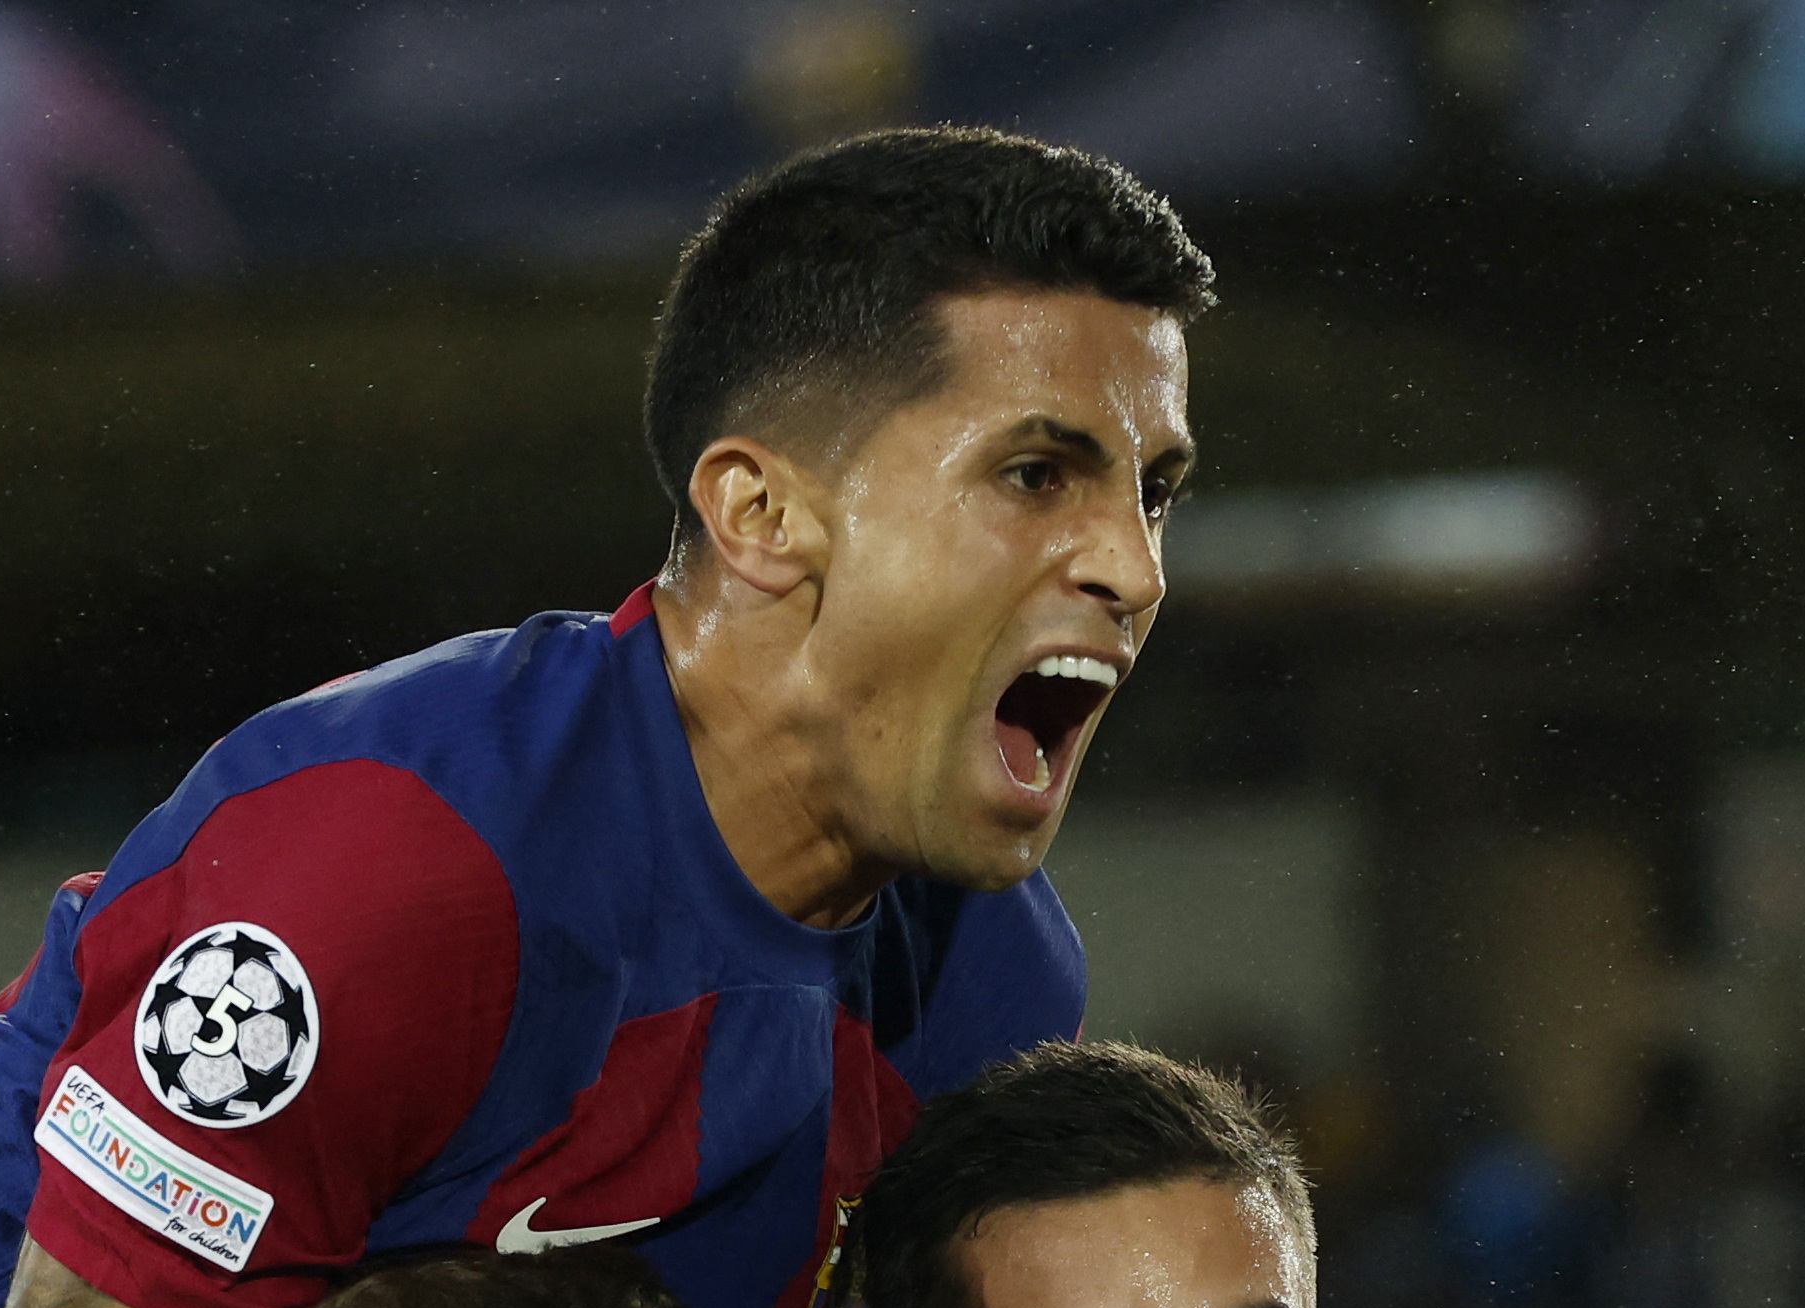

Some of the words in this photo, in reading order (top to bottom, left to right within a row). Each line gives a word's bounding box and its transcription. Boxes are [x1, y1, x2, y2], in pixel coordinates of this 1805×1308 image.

[190, 984, 254, 1057] 5
[67, 1075, 106, 1114] UEFA
[52, 1093, 256, 1244] FOUNDATION
[163, 1216, 186, 1232] for
[189, 1231, 240, 1263] children
